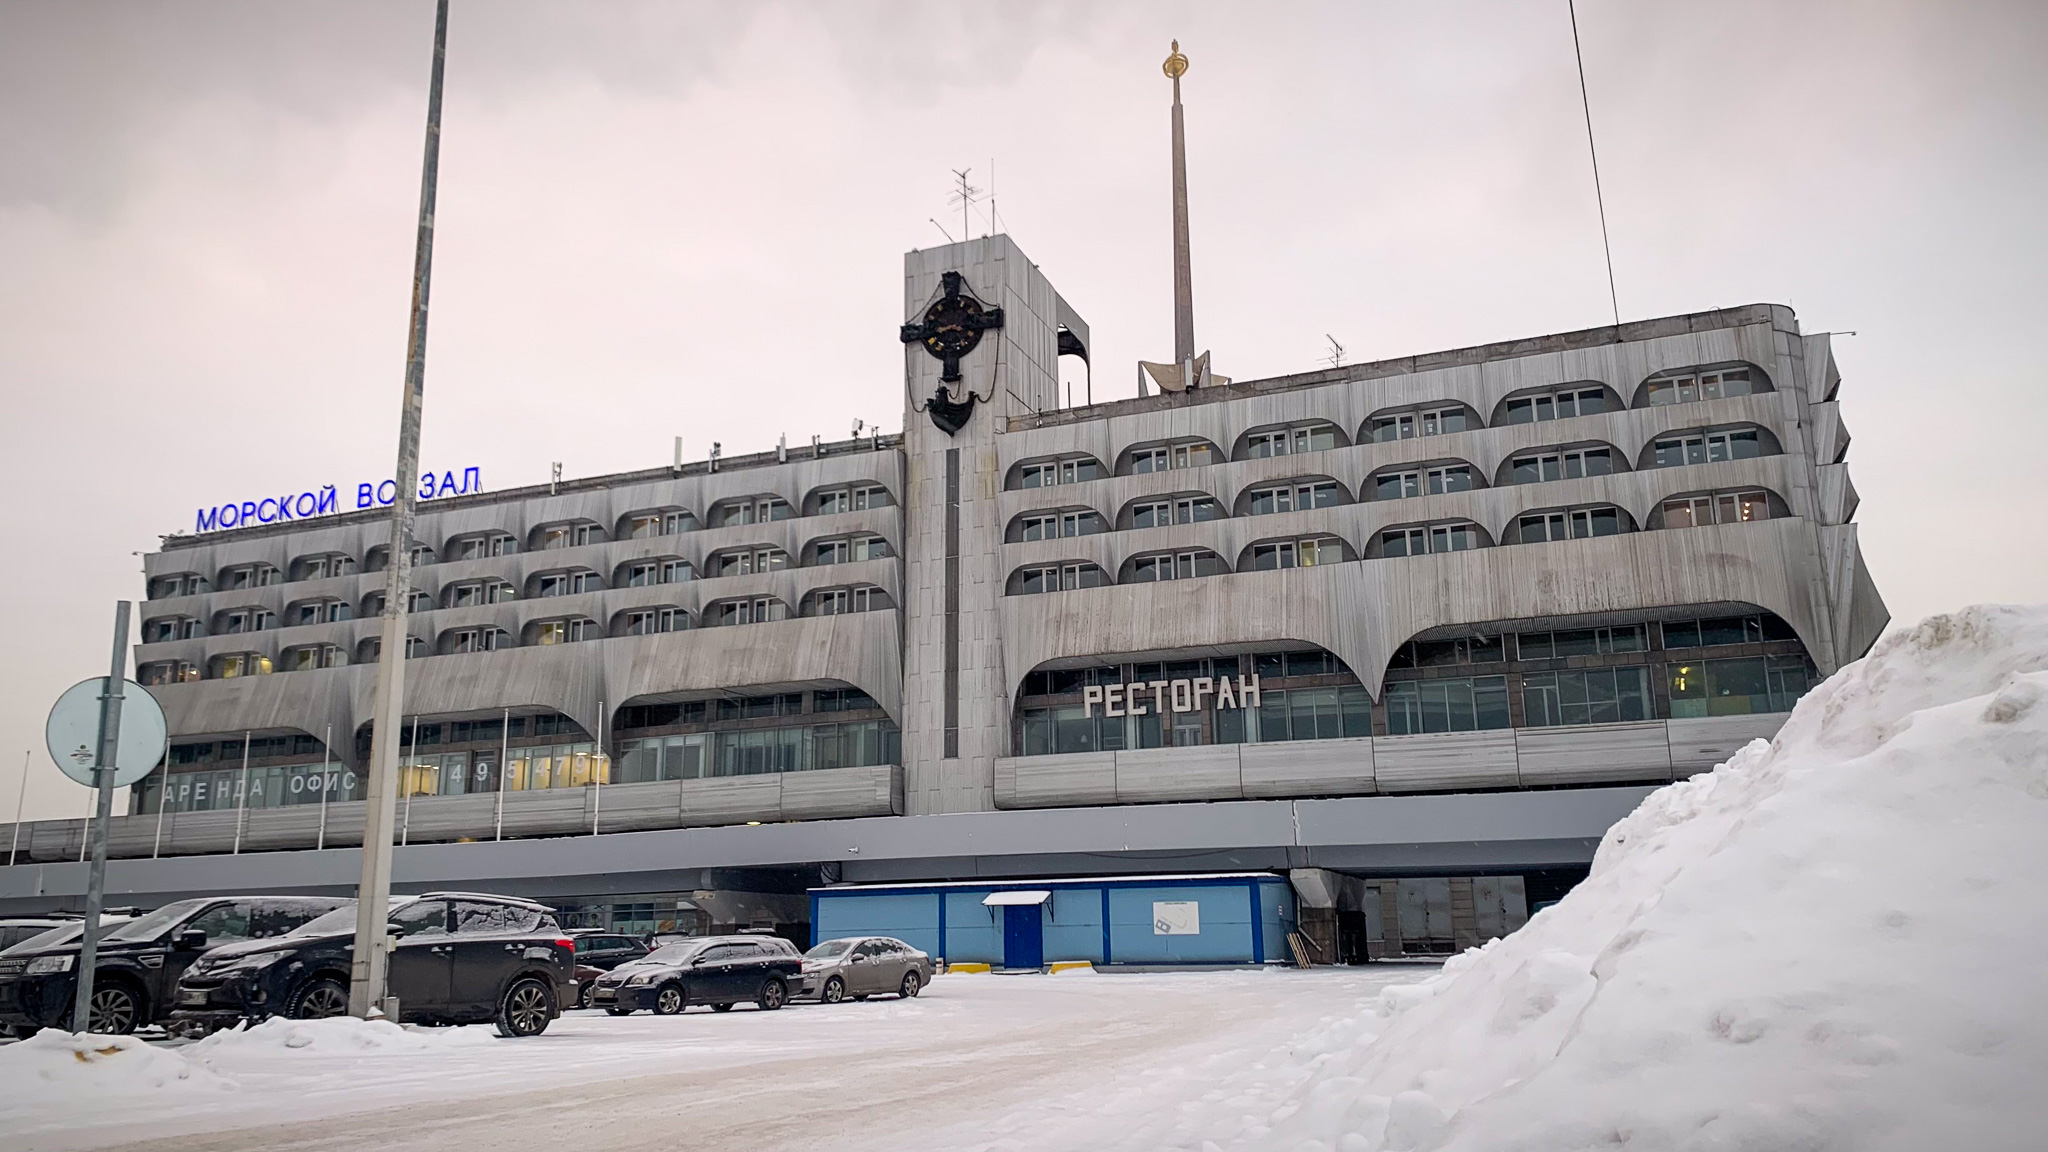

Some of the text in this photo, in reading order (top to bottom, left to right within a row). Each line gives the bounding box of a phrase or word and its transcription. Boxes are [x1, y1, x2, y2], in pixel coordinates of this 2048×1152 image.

[196, 466, 480, 532] МОРСКОЙ ВОЗАЛ
[1083, 673, 1261, 719] РЕСТОРАН
[163, 778, 263, 802] АРЕНДА
